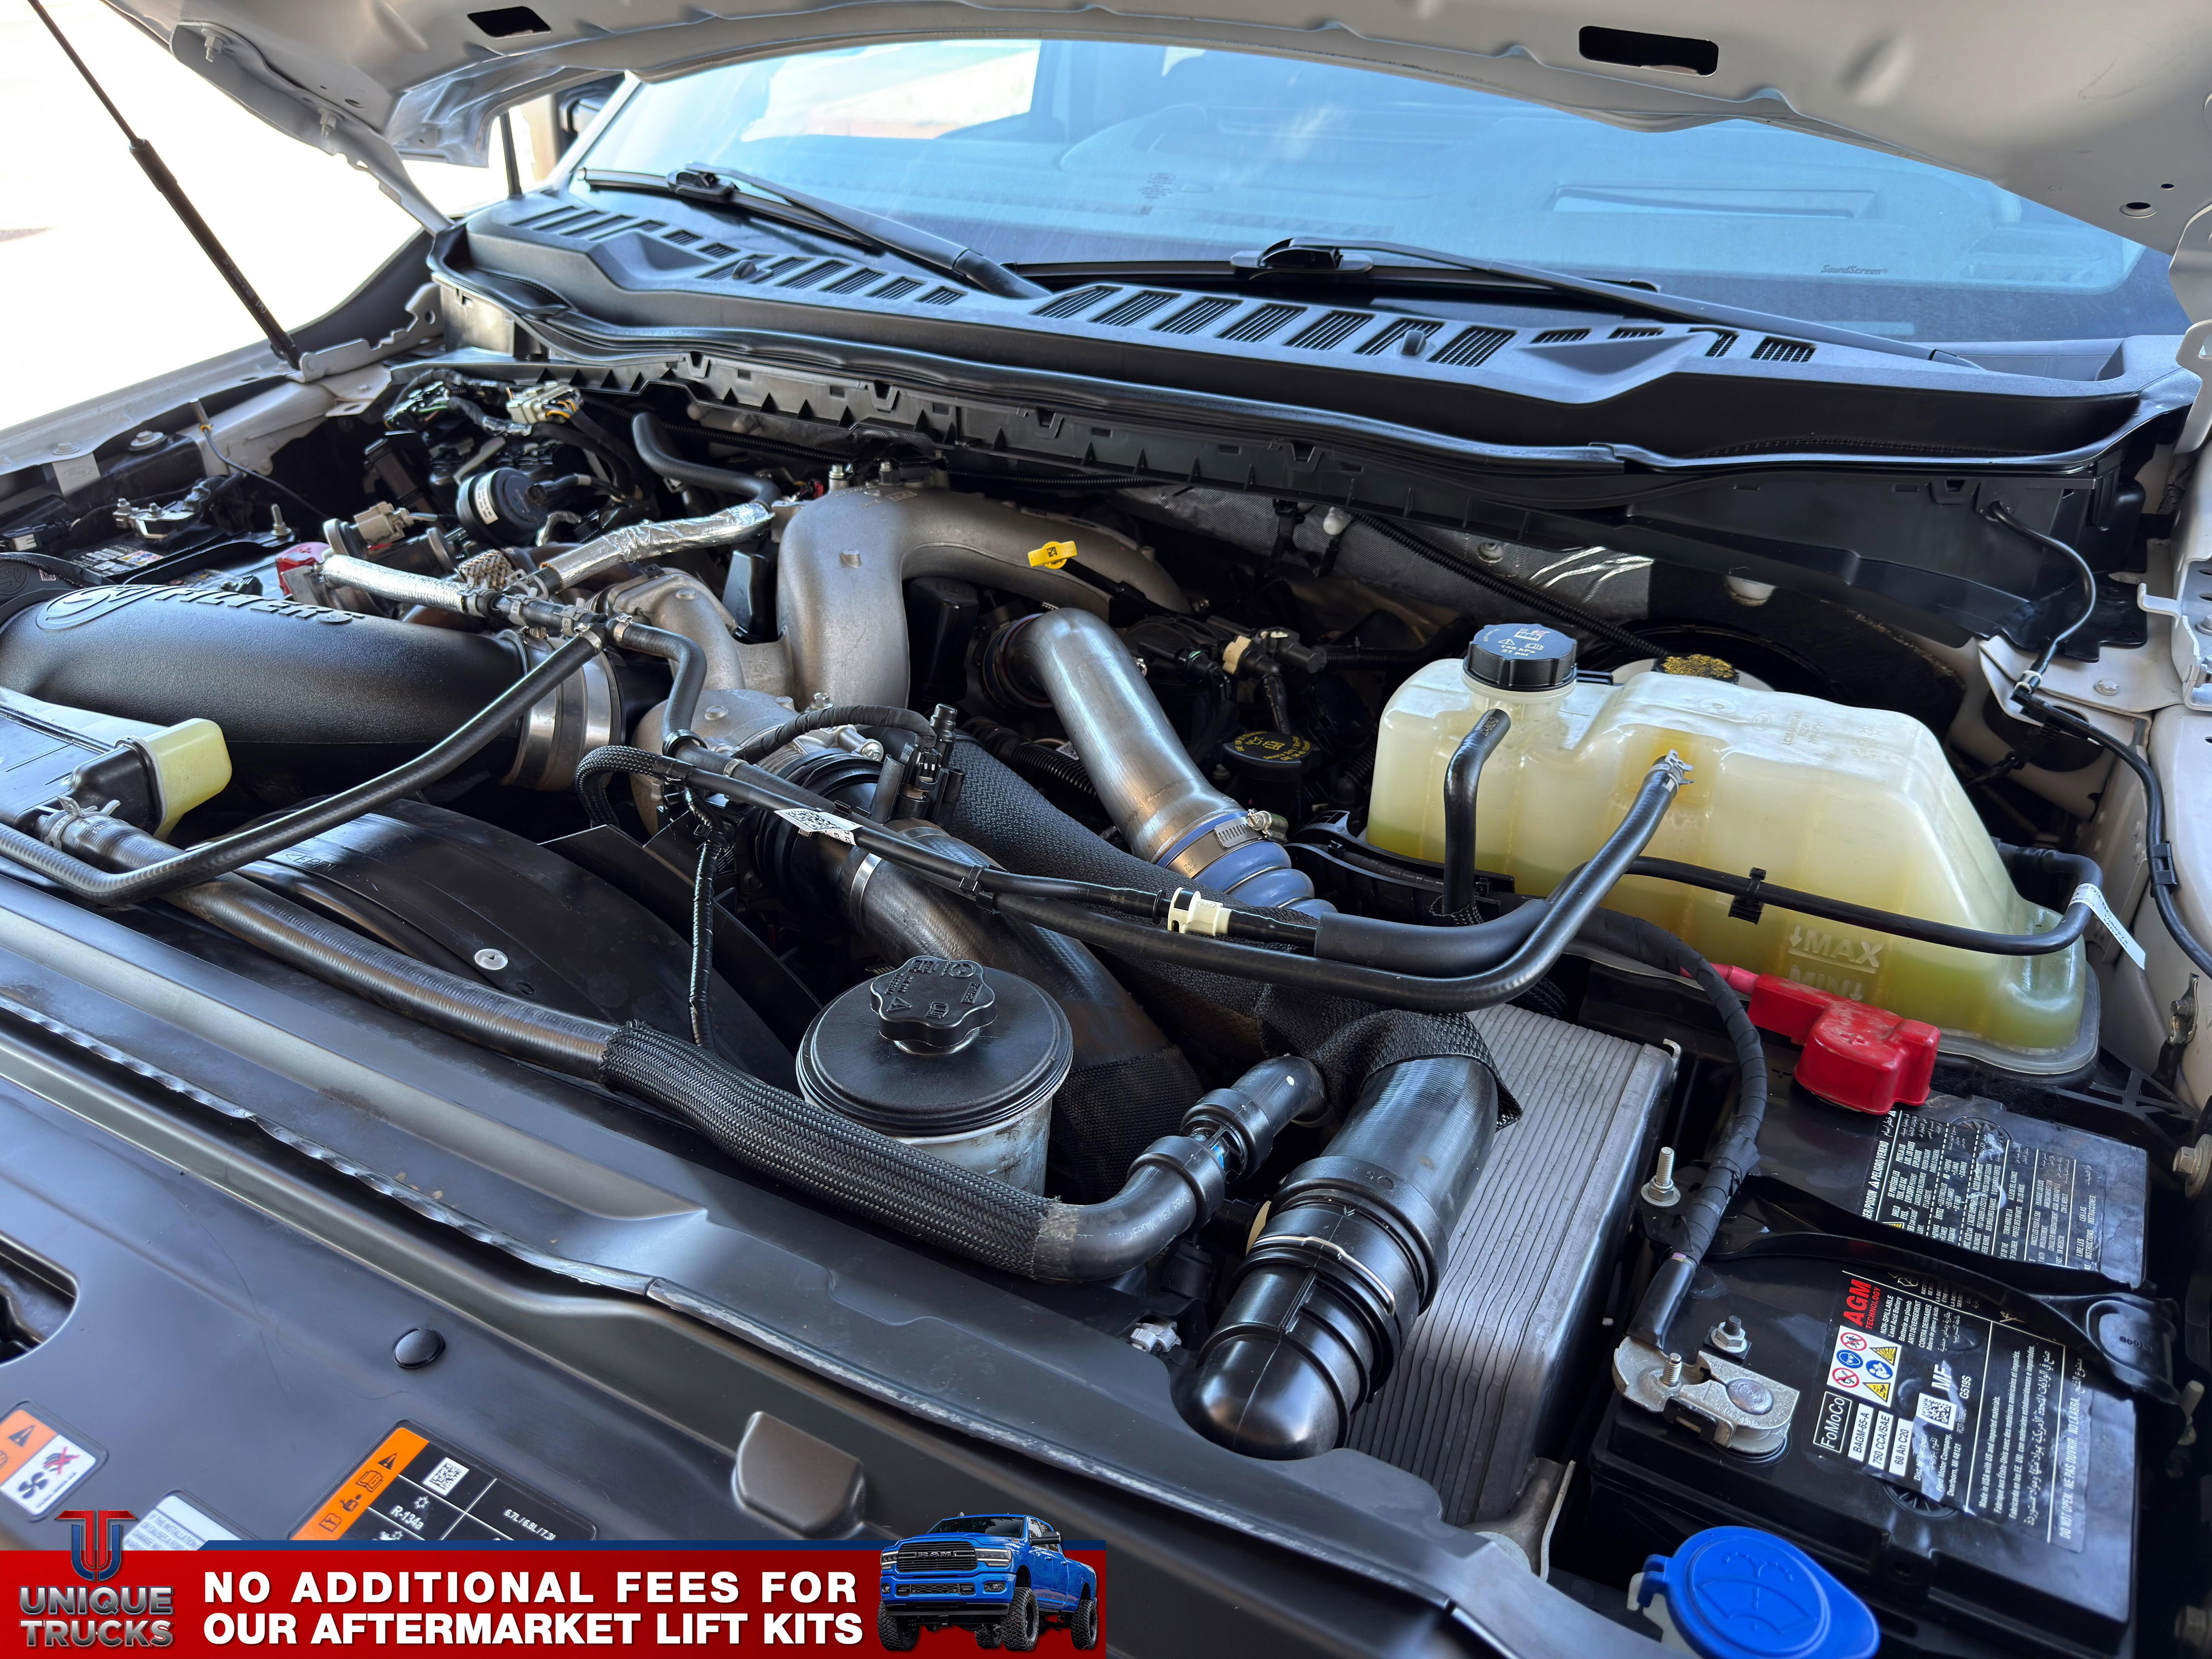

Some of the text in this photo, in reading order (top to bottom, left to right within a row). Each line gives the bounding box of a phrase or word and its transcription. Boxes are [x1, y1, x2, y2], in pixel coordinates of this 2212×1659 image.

[1803, 927, 1884, 968] MAX
[1895, 1149, 1905, 1162] PROTEJA
[1906, 1141, 1915, 1151] GASES
[1911, 1149, 1922, 1168] EXPLOSIVOS
[1870, 1140, 1890, 1181] PELIGRO/VENENO
[1944, 1158, 1952, 1171] CHISPAS
[1951, 1161, 1959, 1173] FLAMAS
[1959, 1161, 1967, 1176] CIGARROS
[1886, 1176, 1899, 1193] PROTÉGER
[1904, 1173, 1917, 1203] EXPLOSIFS PEUVENT
[1891, 1205, 1901, 1217] SHIELD
[1933, 1207, 1944, 1220] ÉVITEZ
[1931, 1224, 1940, 1236] SPARKS
[1939, 1226, 1948, 1240] FLAMES
[1947, 1227, 1956, 1242] SMOKING
[2085, 1228, 2093, 1259] INSTRUCTIONS.
[1842, 1278, 1871, 1327] AGM
[1865, 1286, 1881, 1330] TECHNOLOGY
[1880, 1295, 1894, 1334] NON-SPILLABLE
[1888, 1296, 1902, 1338] Lead Acid Battery
[1898, 1321, 1907, 1341] Batterie
[1904, 1300, 1912, 1316] plomb
[1908, 1299, 1921, 1333] DÉVERSEMENT
[1918, 1303, 1932, 1348] CONTRA DERRAMES
[1929, 1319, 1937, 1332] plomo
[2010, 1349, 2021, 1373] importés.
[2025, 1344, 2036, 1373] importados.
[2039, 1362, 2053, 1372] في
[2042, 1350, 2055, 1365] صنع
[1931, 1363, 1953, 1392] MF
[1959, 1374, 1972, 1399] G519S
[2007, 1377, 2017, 1404] américains
[2020, 1375, 2032, 1415] estadounidenses
[1990, 1394, 2000, 1419] materials.
[2004, 1403, 2014, 1428] matériaux
[1821, 1395, 1845, 1449] FoMoCo
[1853, 1411, 1869, 1454] BAGM-65-A
[1987, 1419, 1998, 1443] imported
[2003, 1427, 2011, 1438] des
[2018, 1414, 2027, 1442] materiales
[1873, 1414, 1890, 1465] 750 CCA/SAE
[1894, 1427, 1909, 1466] 68 Ah C20
[1940, 1432, 1952, 1461] Company,
[1985, 1441, 1994, 1453] and
[1938, 1460, 1946, 1478] Motor
[1947, 1442, 1961, 1497] Dearborn, MI 48121
[1983, 1460, 1992, 1474] with
[1984, 1452, 1993, 1462] US
[1995, 1449, 2008, 1479] États-Unis
[2015, 1452, 2023, 1464] UU.
[2059, 1394, 2080, 1540] DO NOT OPEN. NE PAS OUVRIR. NO LA ABRA.
[1914, 1467, 1922, 1481] Dist.
[1981, 1473, 1990, 1486] USA
[2013, 1472, 2021, 1482] los
[2013, 1482, 2020, 1490] en
[1979, 1491, 1988, 1508] Made
[1993, 1488, 2005, 1514] Fabriqué
[2008, 1488, 2020, 1519] Fabricardo
[390, 1504, 424, 1531] R-134a
[504, 1509, 520, 1522] 6.7L
[523, 1519, 538, 1533] 6.8L
